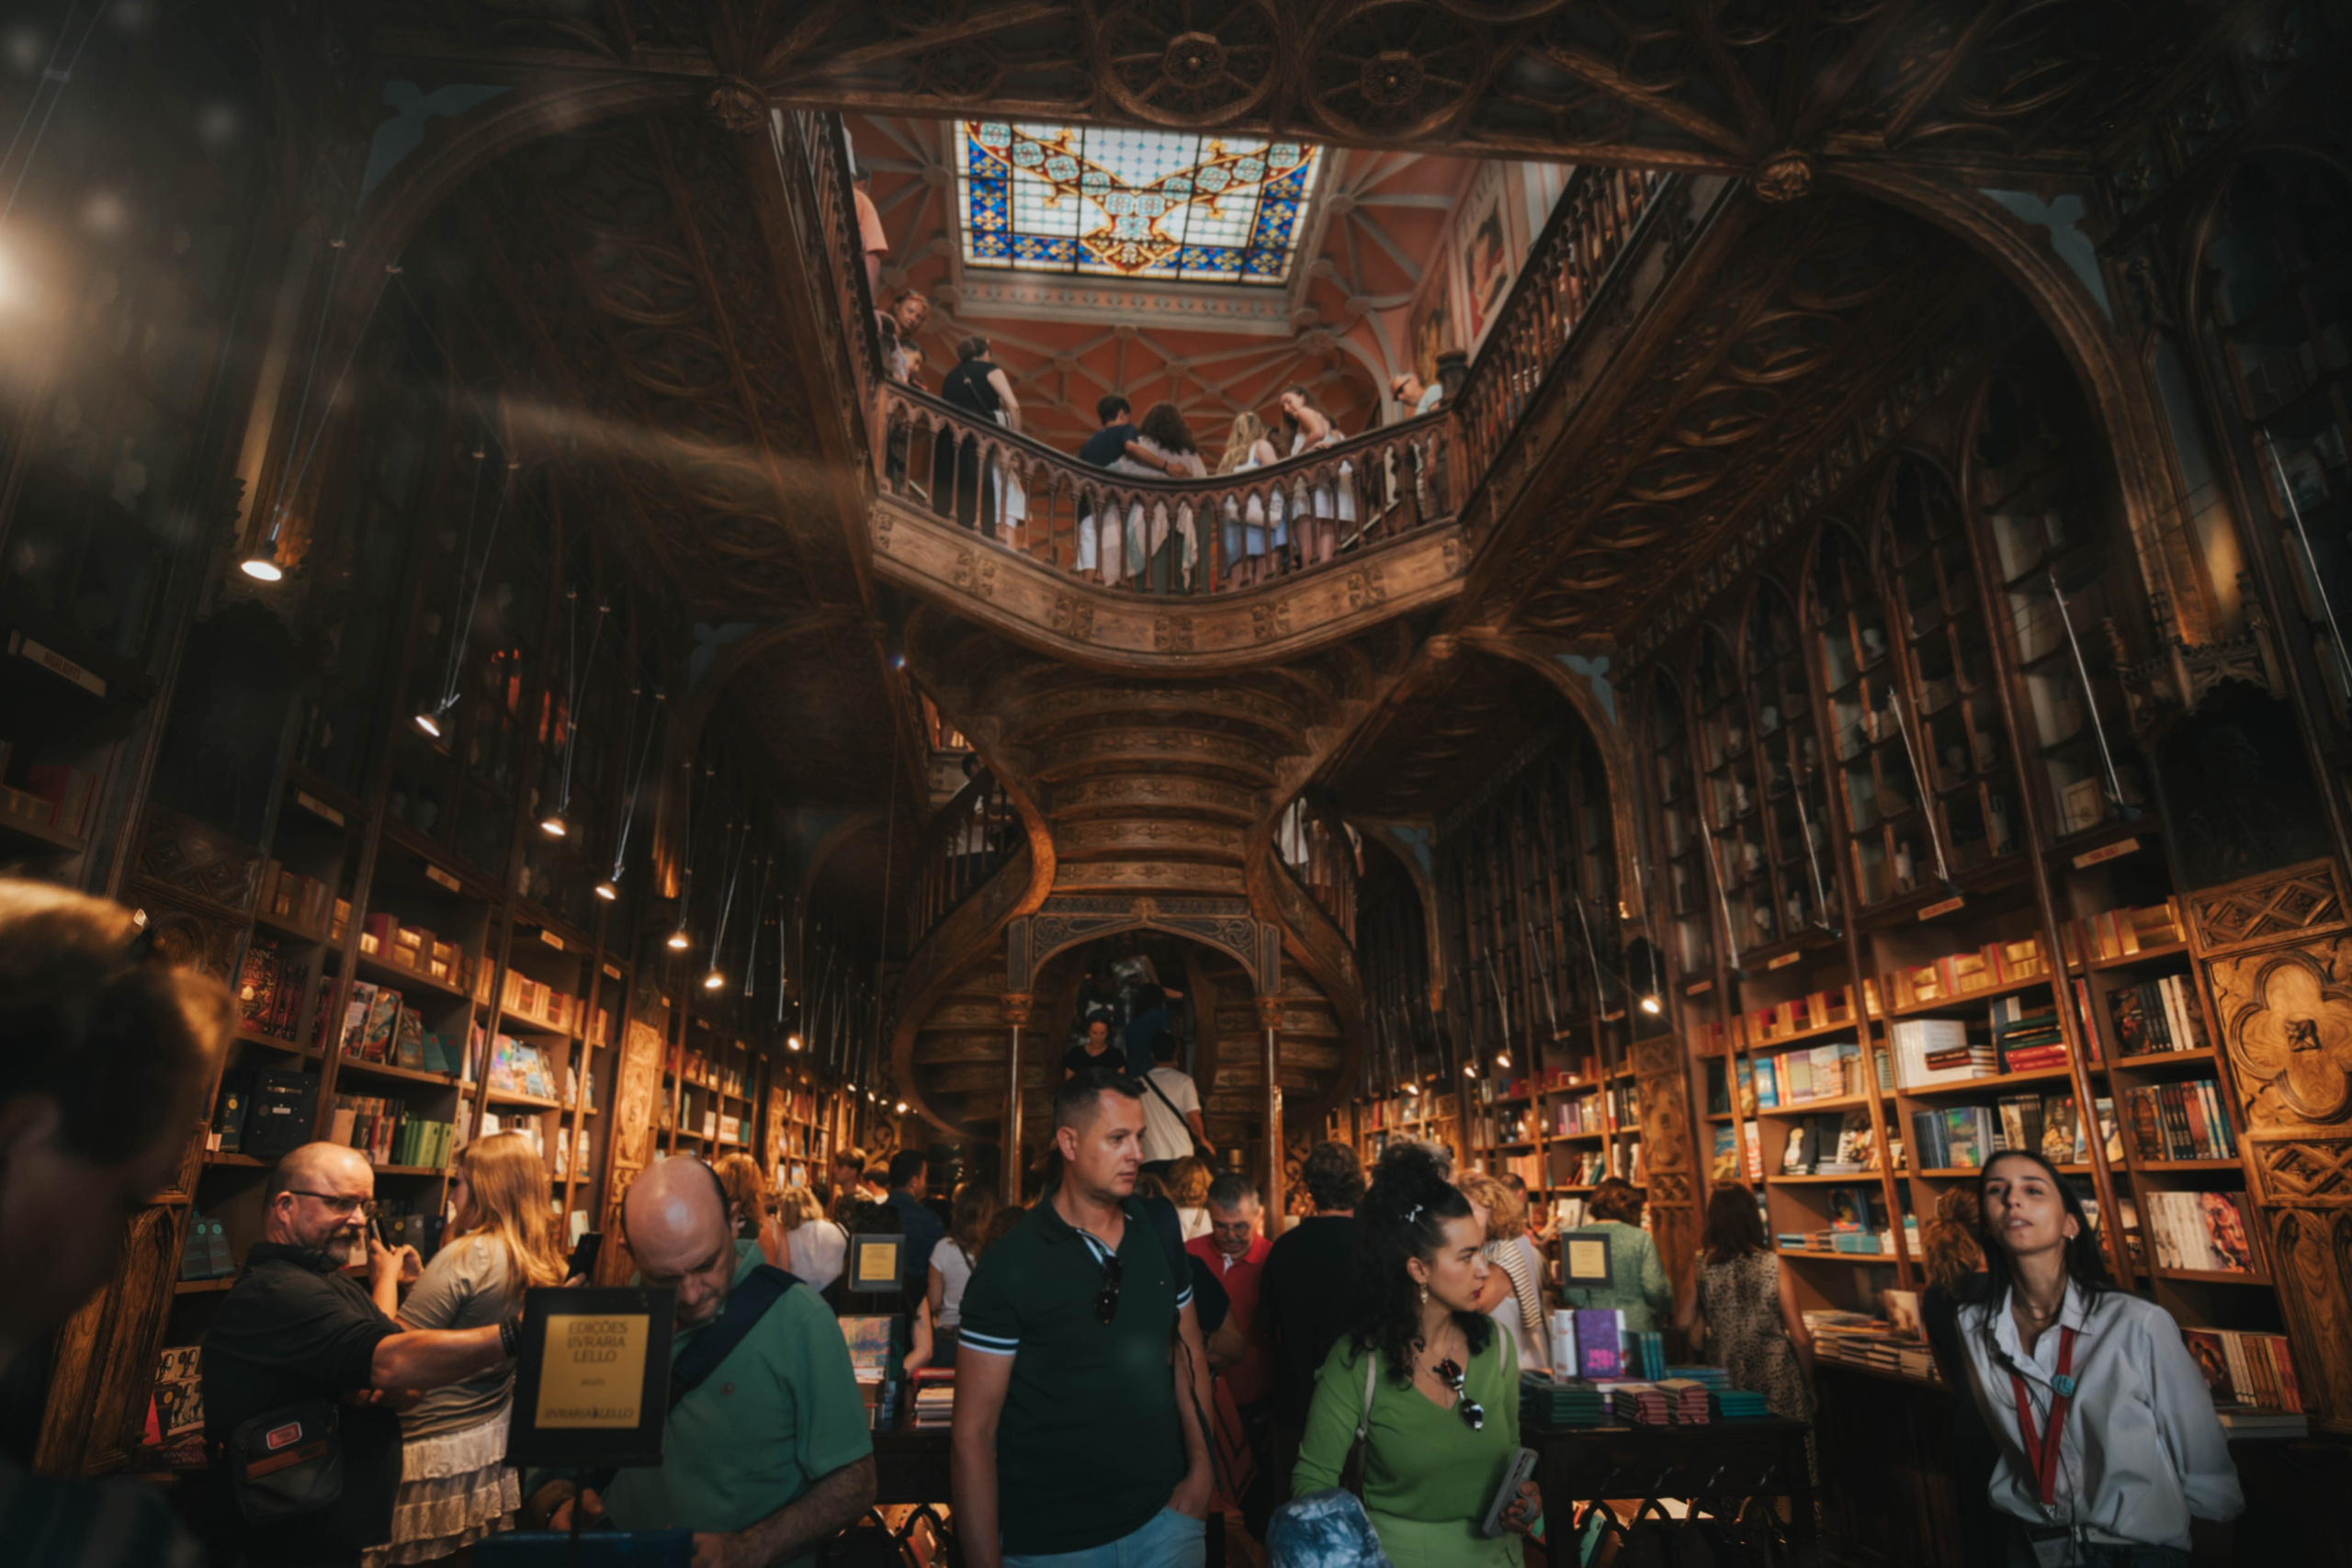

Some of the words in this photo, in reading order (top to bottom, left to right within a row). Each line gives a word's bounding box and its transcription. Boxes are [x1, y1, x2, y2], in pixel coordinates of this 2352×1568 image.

[43, 650, 81, 682] HIGHLIGHTS
[569, 1320, 628, 1336] EDIÇÕES
[567, 1336, 627, 1348] LIVRARIA
[573, 1349, 617, 1363] LELLO
[599, 1407, 634, 1419] LELLO
